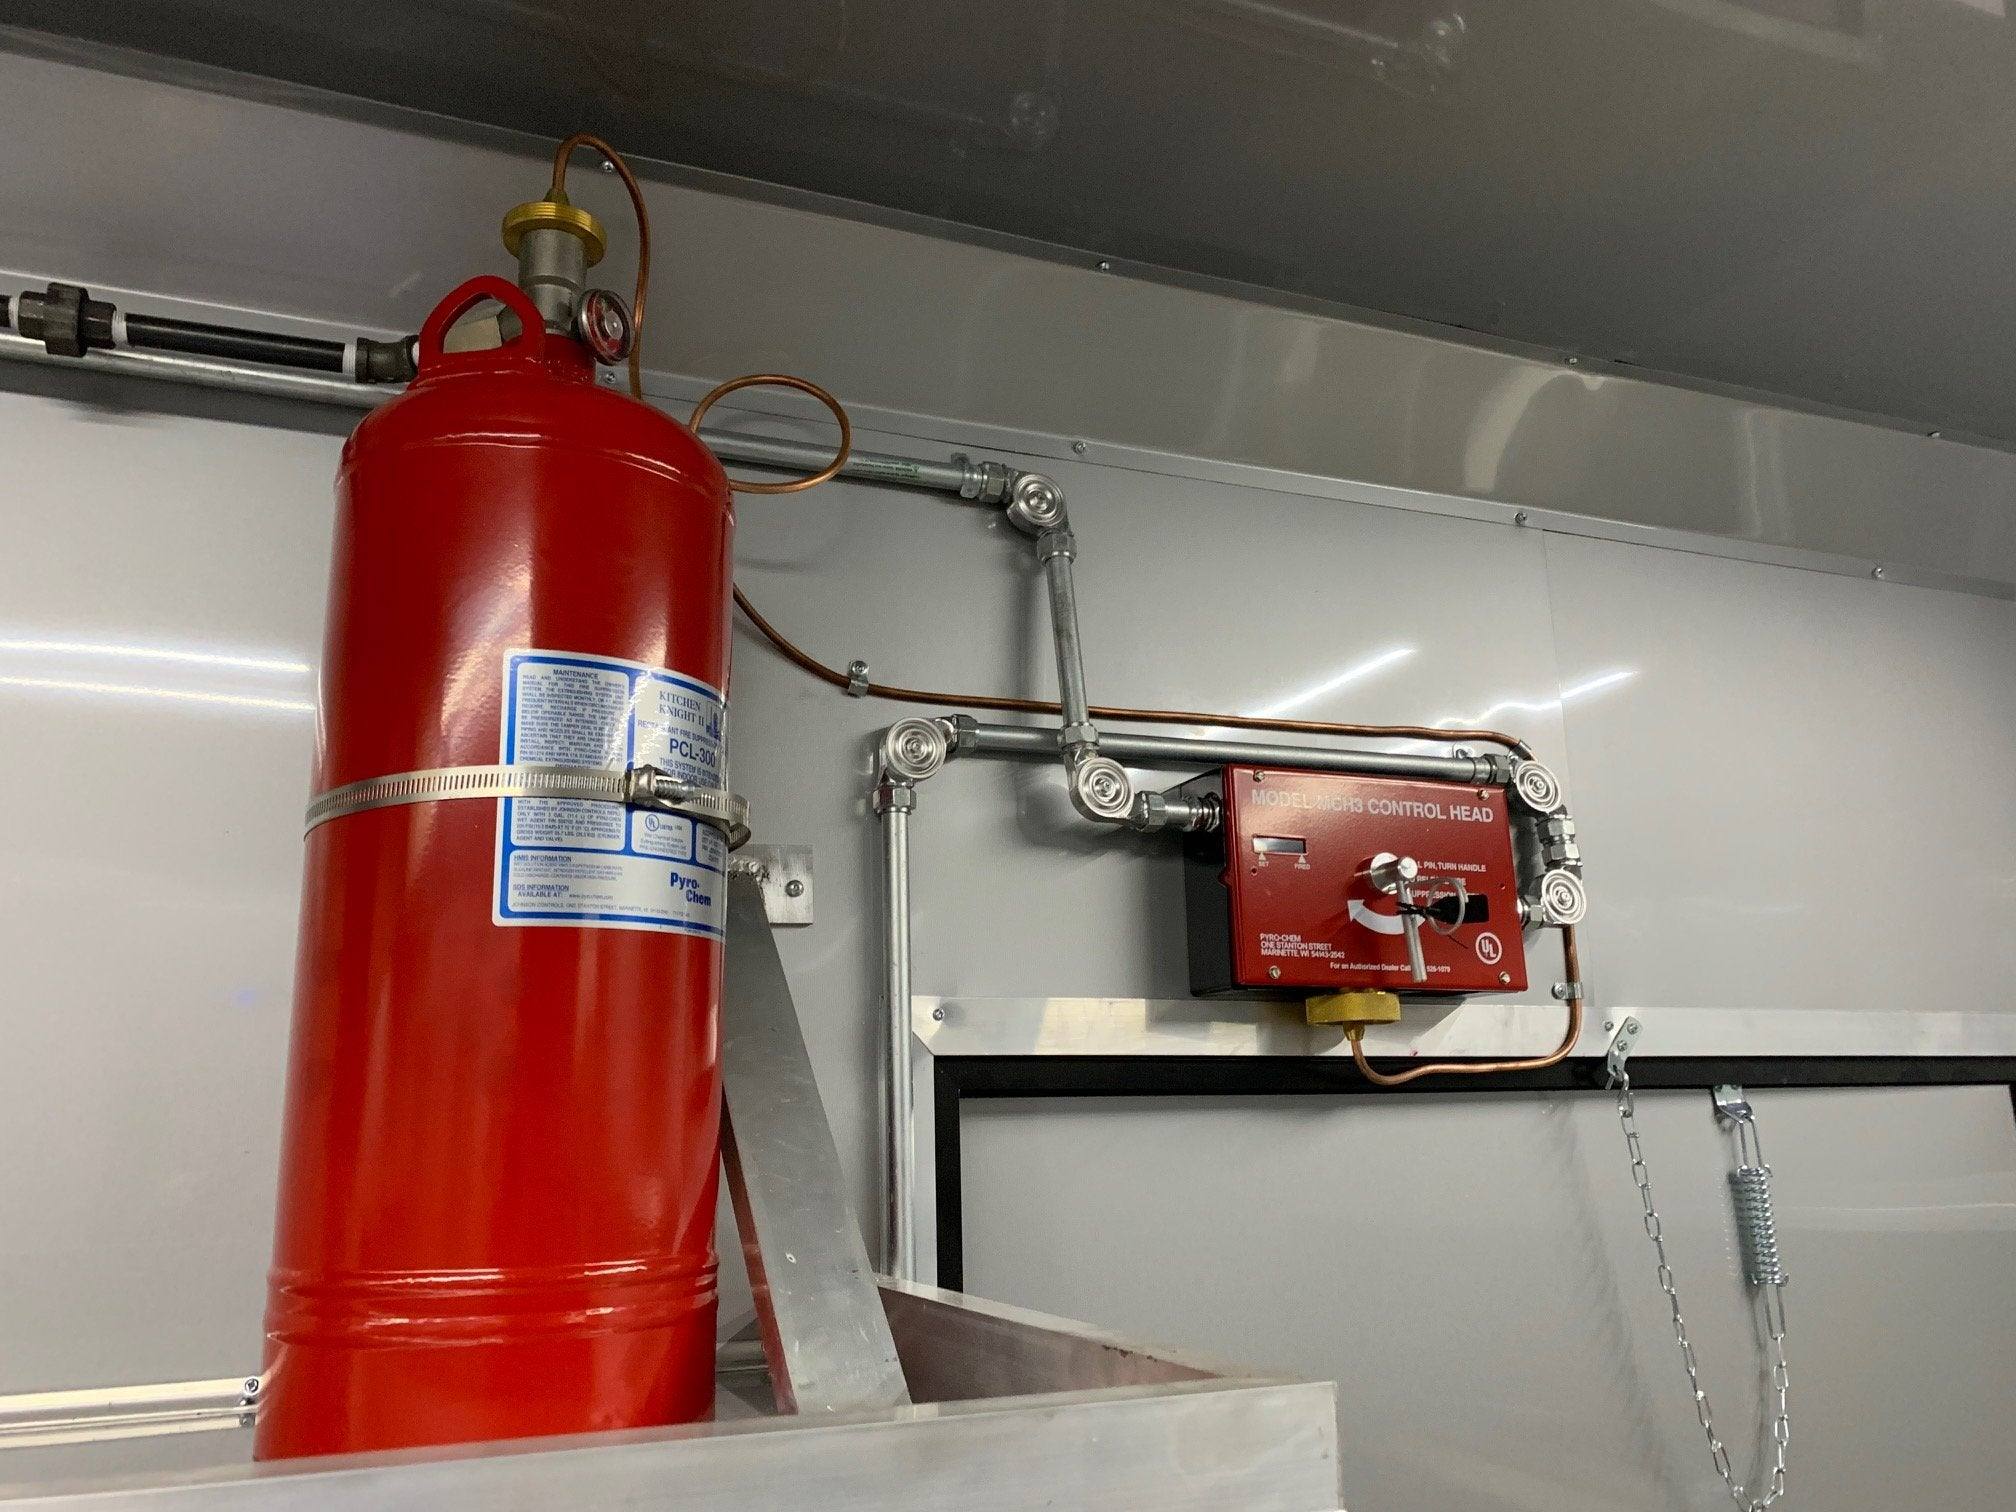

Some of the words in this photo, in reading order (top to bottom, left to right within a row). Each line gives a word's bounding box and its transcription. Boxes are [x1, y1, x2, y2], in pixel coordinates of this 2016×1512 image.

[553, 669, 598, 678] MAINTENANCE
[660, 690, 701, 712] KITCHEN
[660, 704, 696, 722] KNIGHT
[670, 738, 715, 768] PCL-300
[660, 757, 674, 768] THIS
[675, 760, 696, 773] SYSTEM
[1252, 789, 1312, 809] MODEL
[1367, 799, 1446, 820] CONTROL
[1450, 805, 1494, 822] HEAD
[1438, 862, 1456, 870] TURN
[1458, 864, 1486, 872] HANDLE
[670, 872, 700, 890] Pyro-
[686, 890, 712, 907] Chem
[1260, 933, 1301, 943] PYRO-CHEM
